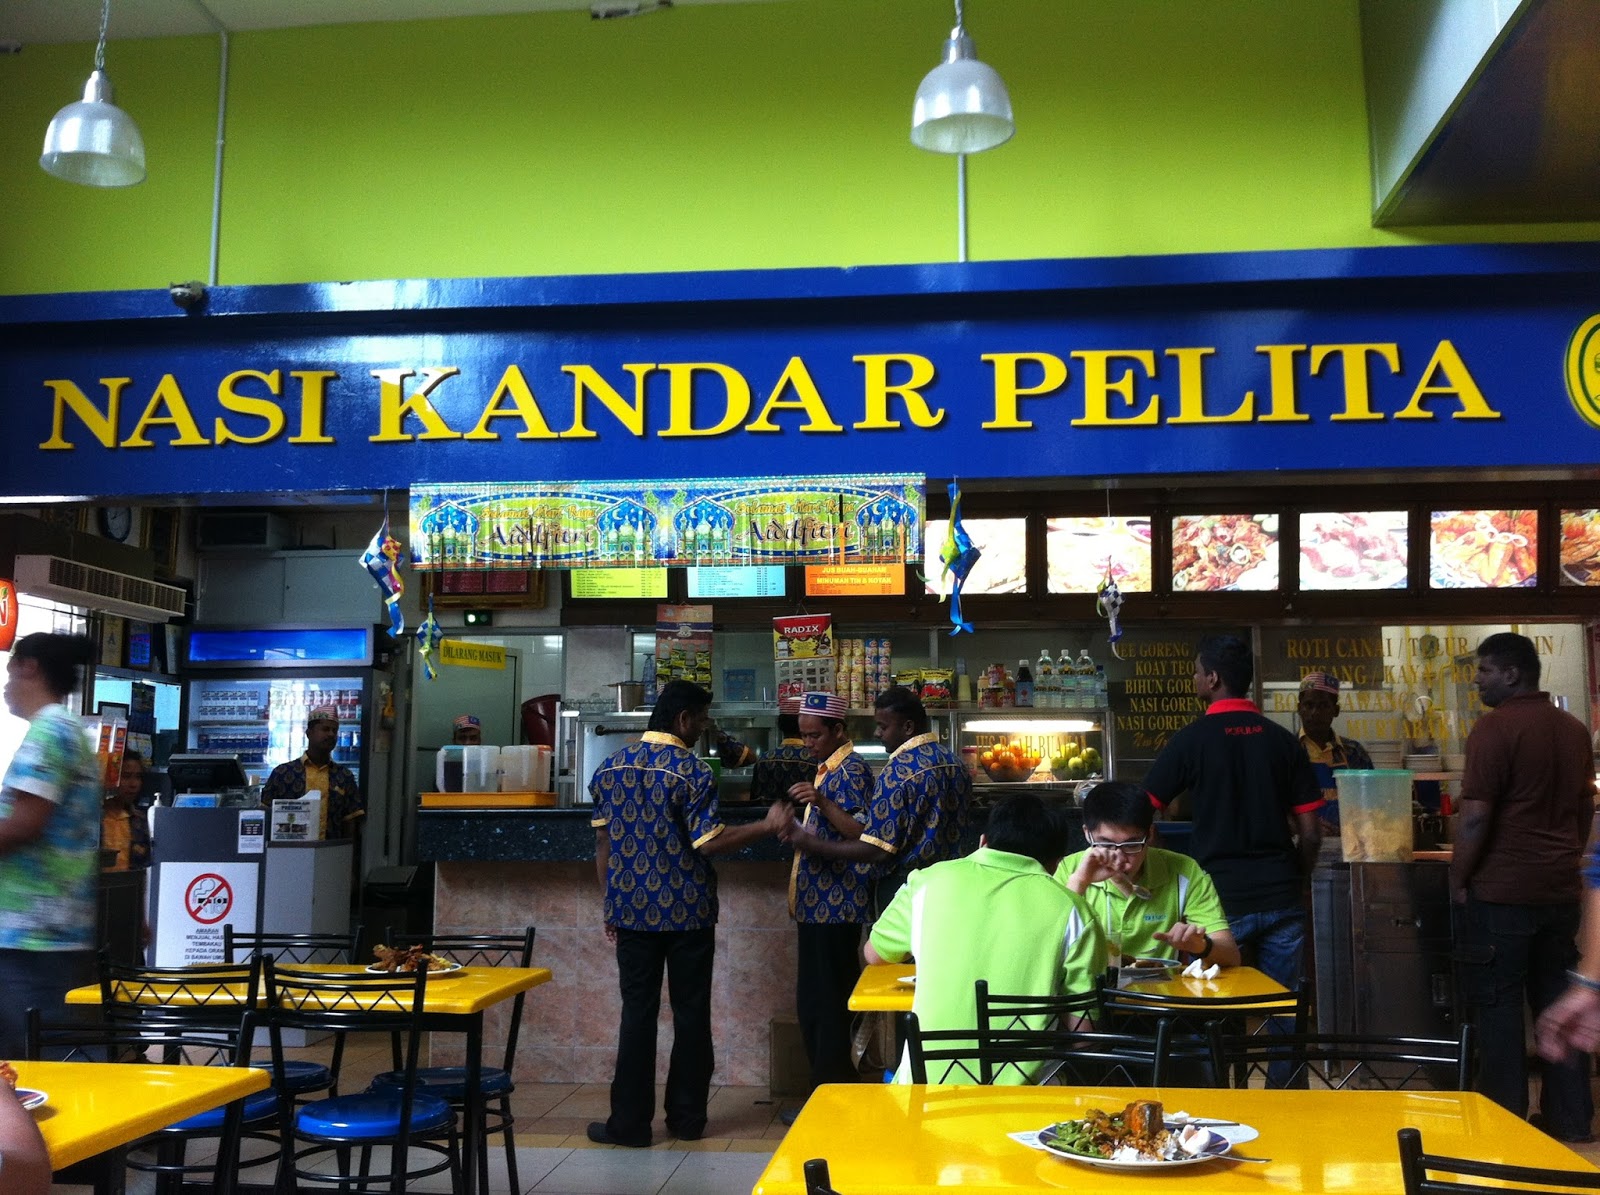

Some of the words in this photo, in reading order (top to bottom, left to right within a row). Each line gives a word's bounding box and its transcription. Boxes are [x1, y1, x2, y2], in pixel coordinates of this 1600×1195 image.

[38, 368, 338, 450] NASI
[368, 354, 946, 443] KANDAR
[981, 339, 1502, 431] PELITA
[784, 625, 819, 634] RADIX
[443, 646, 478, 661] DILARANG
[479, 650, 502, 663] MASUK
[1139, 642, 1189, 658] GORENG
[1287, 638, 1330, 657] ROTI
[1336, 638, 1393, 657] CANAI
[1135, 661, 1167, 676] KOAY
[1171, 660, 1196, 676] TEO
[1125, 679, 1164, 695] BIHUN
[1166, 679, 1199, 695] GORE
[1130, 697, 1158, 713] NASI
[1273, 692, 1299, 712] BO
[1117, 715, 1145, 730] NASI
